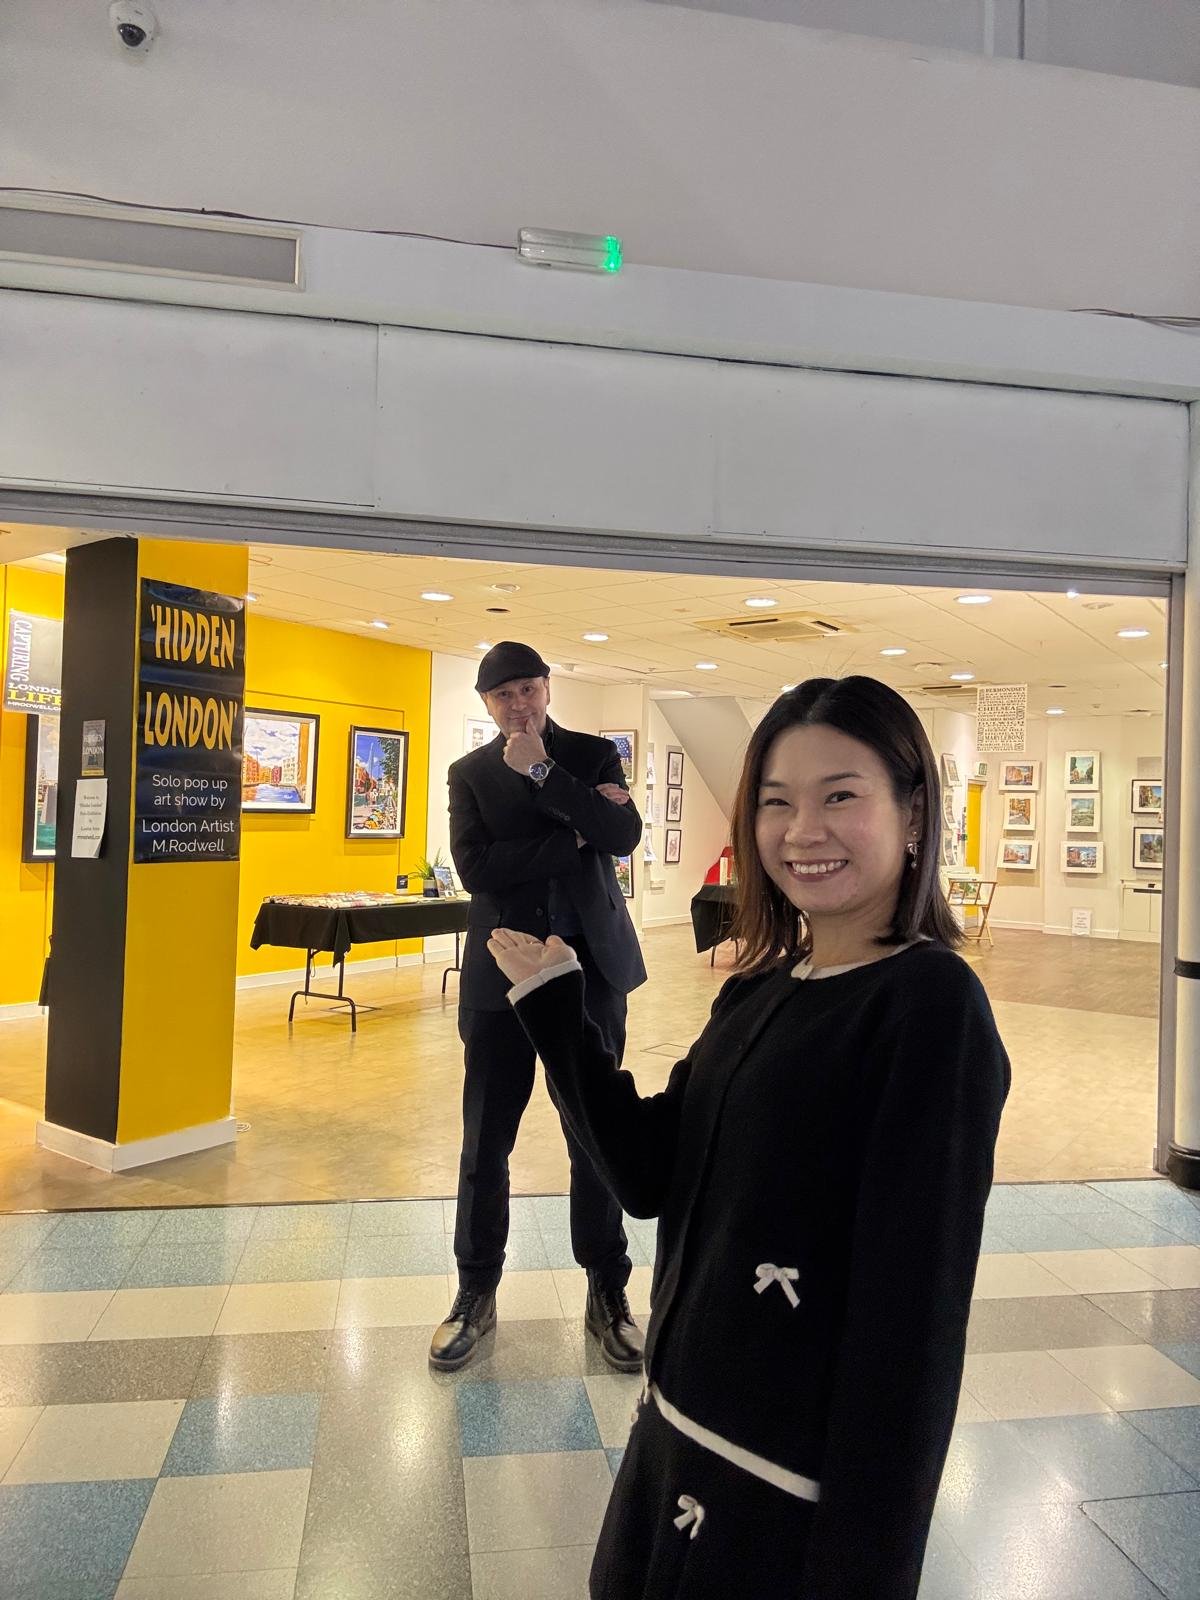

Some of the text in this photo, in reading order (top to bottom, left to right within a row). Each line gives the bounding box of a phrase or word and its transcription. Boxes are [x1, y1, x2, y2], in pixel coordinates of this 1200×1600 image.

[151, 604, 235, 670] 'HIDDEN
[10, 619, 32, 682] CAPTURING
[8, 682, 61, 694] LONDO
[144, 691, 237, 750] LONDON'
[152, 774, 228, 790] Solo pop up
[154, 793, 225, 810] art show by
[142, 820, 235, 833] London Artist
[152, 839, 224, 853] M.Rodwell
